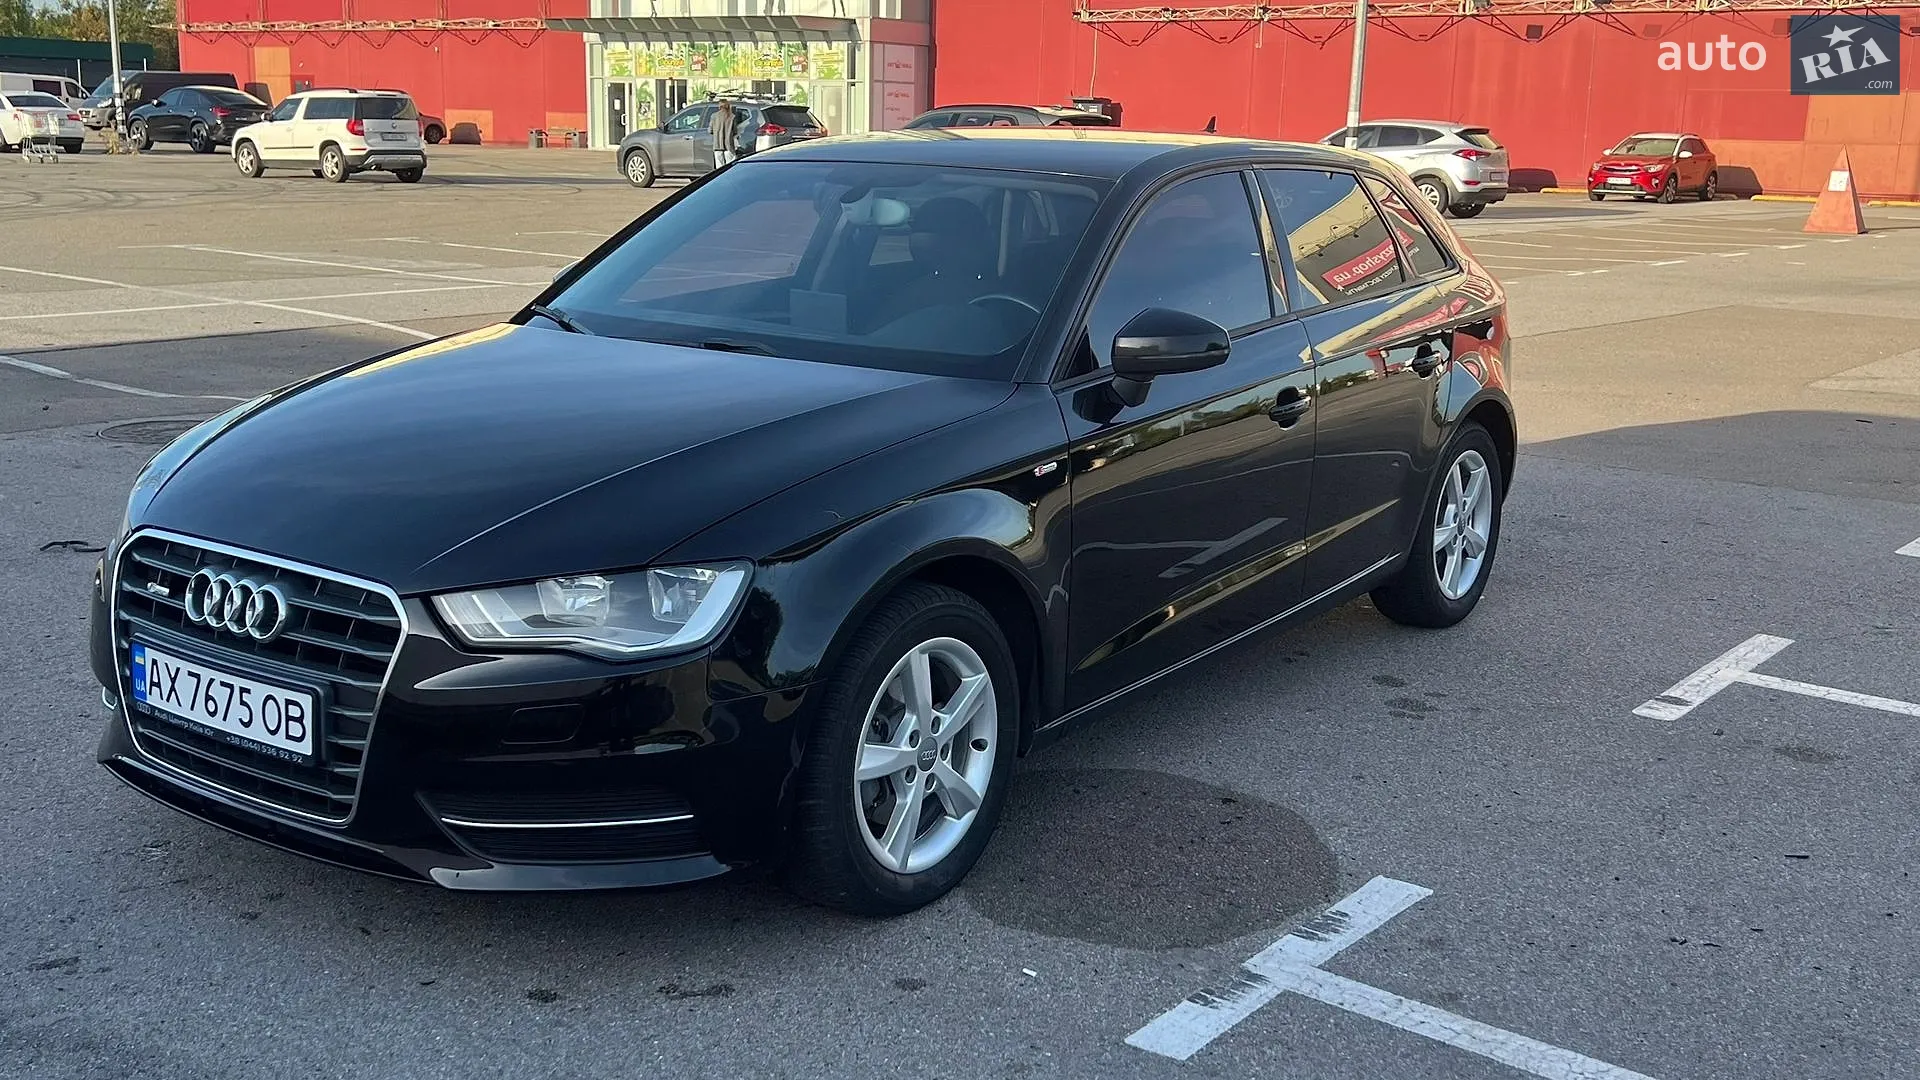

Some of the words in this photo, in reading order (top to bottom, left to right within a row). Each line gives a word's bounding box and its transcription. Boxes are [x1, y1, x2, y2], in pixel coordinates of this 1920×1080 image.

[135, 678, 146, 693] UA
[149, 657, 182, 707] AX
[187, 670, 253, 729] 7675
[261, 694, 307, 743] OB
[261, 745, 277, 756] 536
[278, 750, 290, 760] 92
[291, 753, 304, 763] 92
